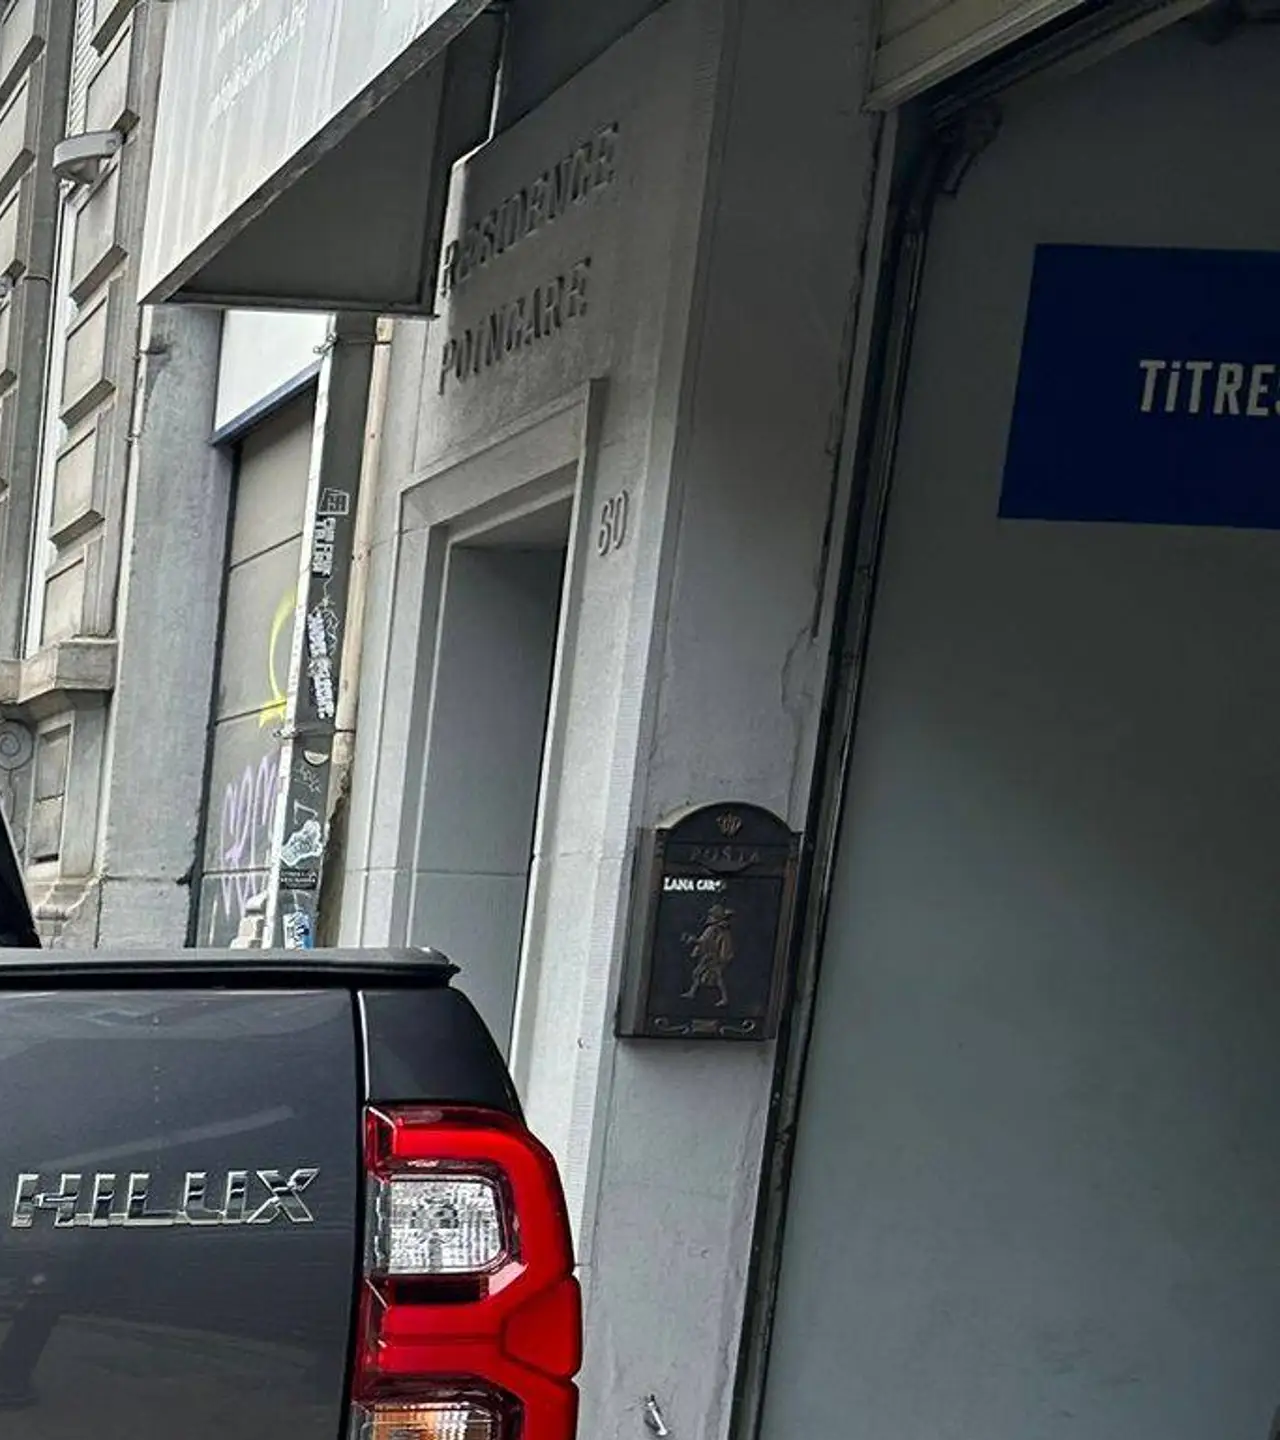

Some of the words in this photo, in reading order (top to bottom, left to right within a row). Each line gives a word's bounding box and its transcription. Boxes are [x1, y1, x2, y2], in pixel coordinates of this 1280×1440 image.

[1139, 359, 1280, 417] TiTRE
[597, 490, 629, 556] 60
[10, 1167, 322, 1228] HILUX
